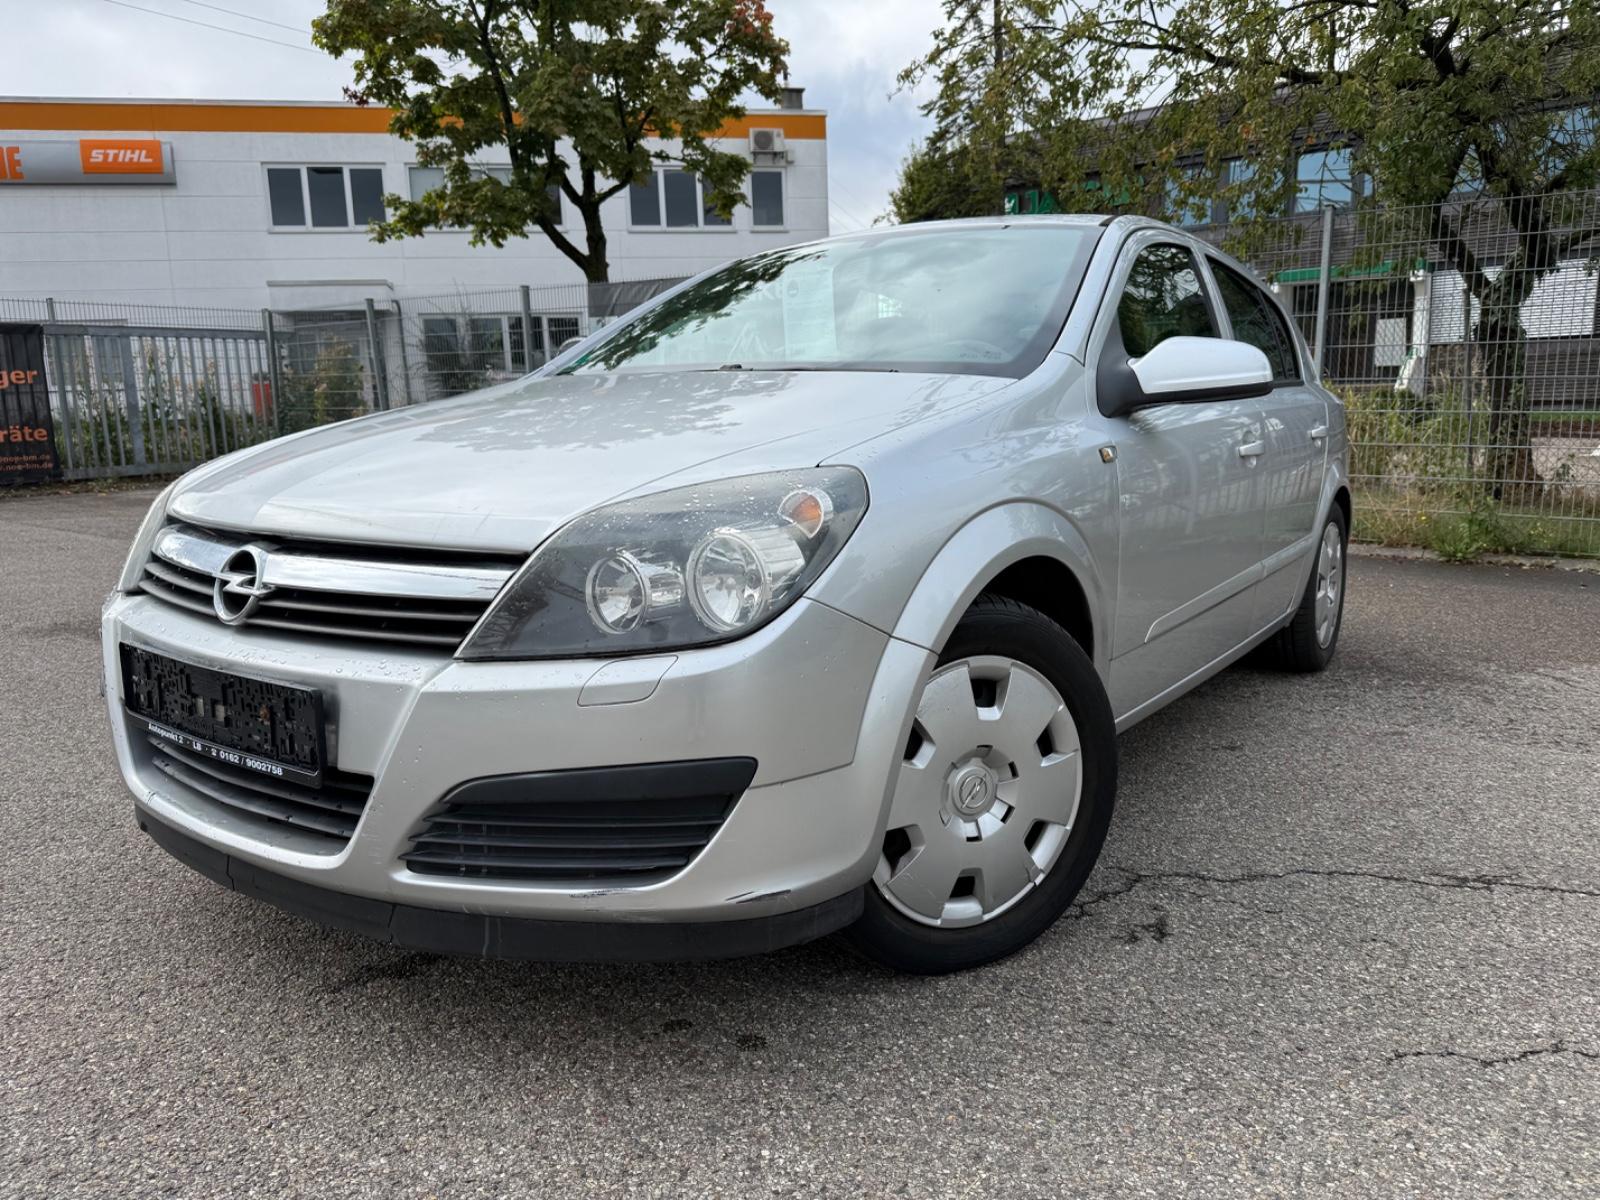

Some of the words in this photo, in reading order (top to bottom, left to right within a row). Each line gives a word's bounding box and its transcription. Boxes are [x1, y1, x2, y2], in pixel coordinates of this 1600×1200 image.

[89, 149, 153, 163] STIHL
[219, 750, 240, 764] 0162
[246, 758, 283, 776] 9002758
